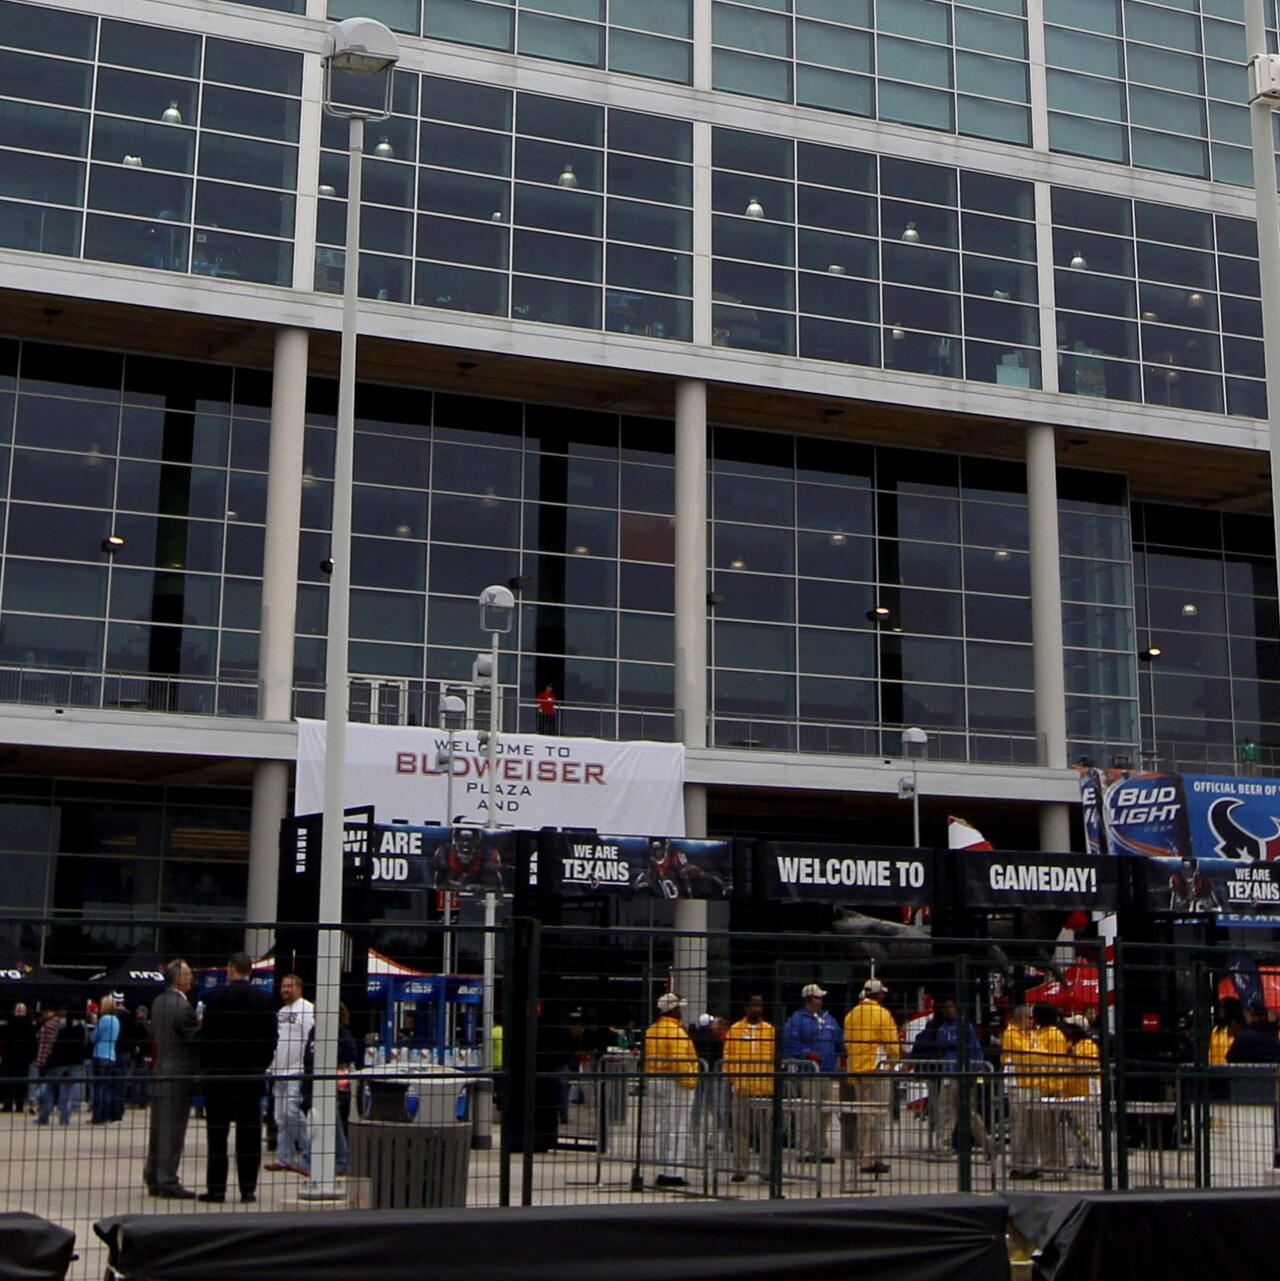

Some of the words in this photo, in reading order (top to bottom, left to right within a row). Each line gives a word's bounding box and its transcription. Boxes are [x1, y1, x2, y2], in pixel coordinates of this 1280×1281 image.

[545, 746, 571, 758] TO
[466, 782, 532, 797] PLAZA
[1117, 786, 1176, 807] BUD
[1194, 781, 1237, 795] OFFICIAL
[1238, 783, 1263, 795] BEER
[1264, 785, 1277, 796] OF
[476, 799, 520, 812] AND
[1108, 804, 1181, 825] LIGHT
[380, 831, 422, 855] ARE
[574, 844, 594, 858] WE
[595, 846, 618, 859] ARE
[354, 857, 409, 881] OUD
[562, 858, 630, 882] TEXANS
[777, 855, 891, 886] WELCOME
[896, 861, 925, 888] TO
[989, 864, 1098, 892] GAMEDAY!
[1235, 868, 1251, 880] WE
[1252, 869, 1270, 881] ARE
[1227, 881, 1280, 900] TEXANS
[129, 970, 165, 982] nrg
